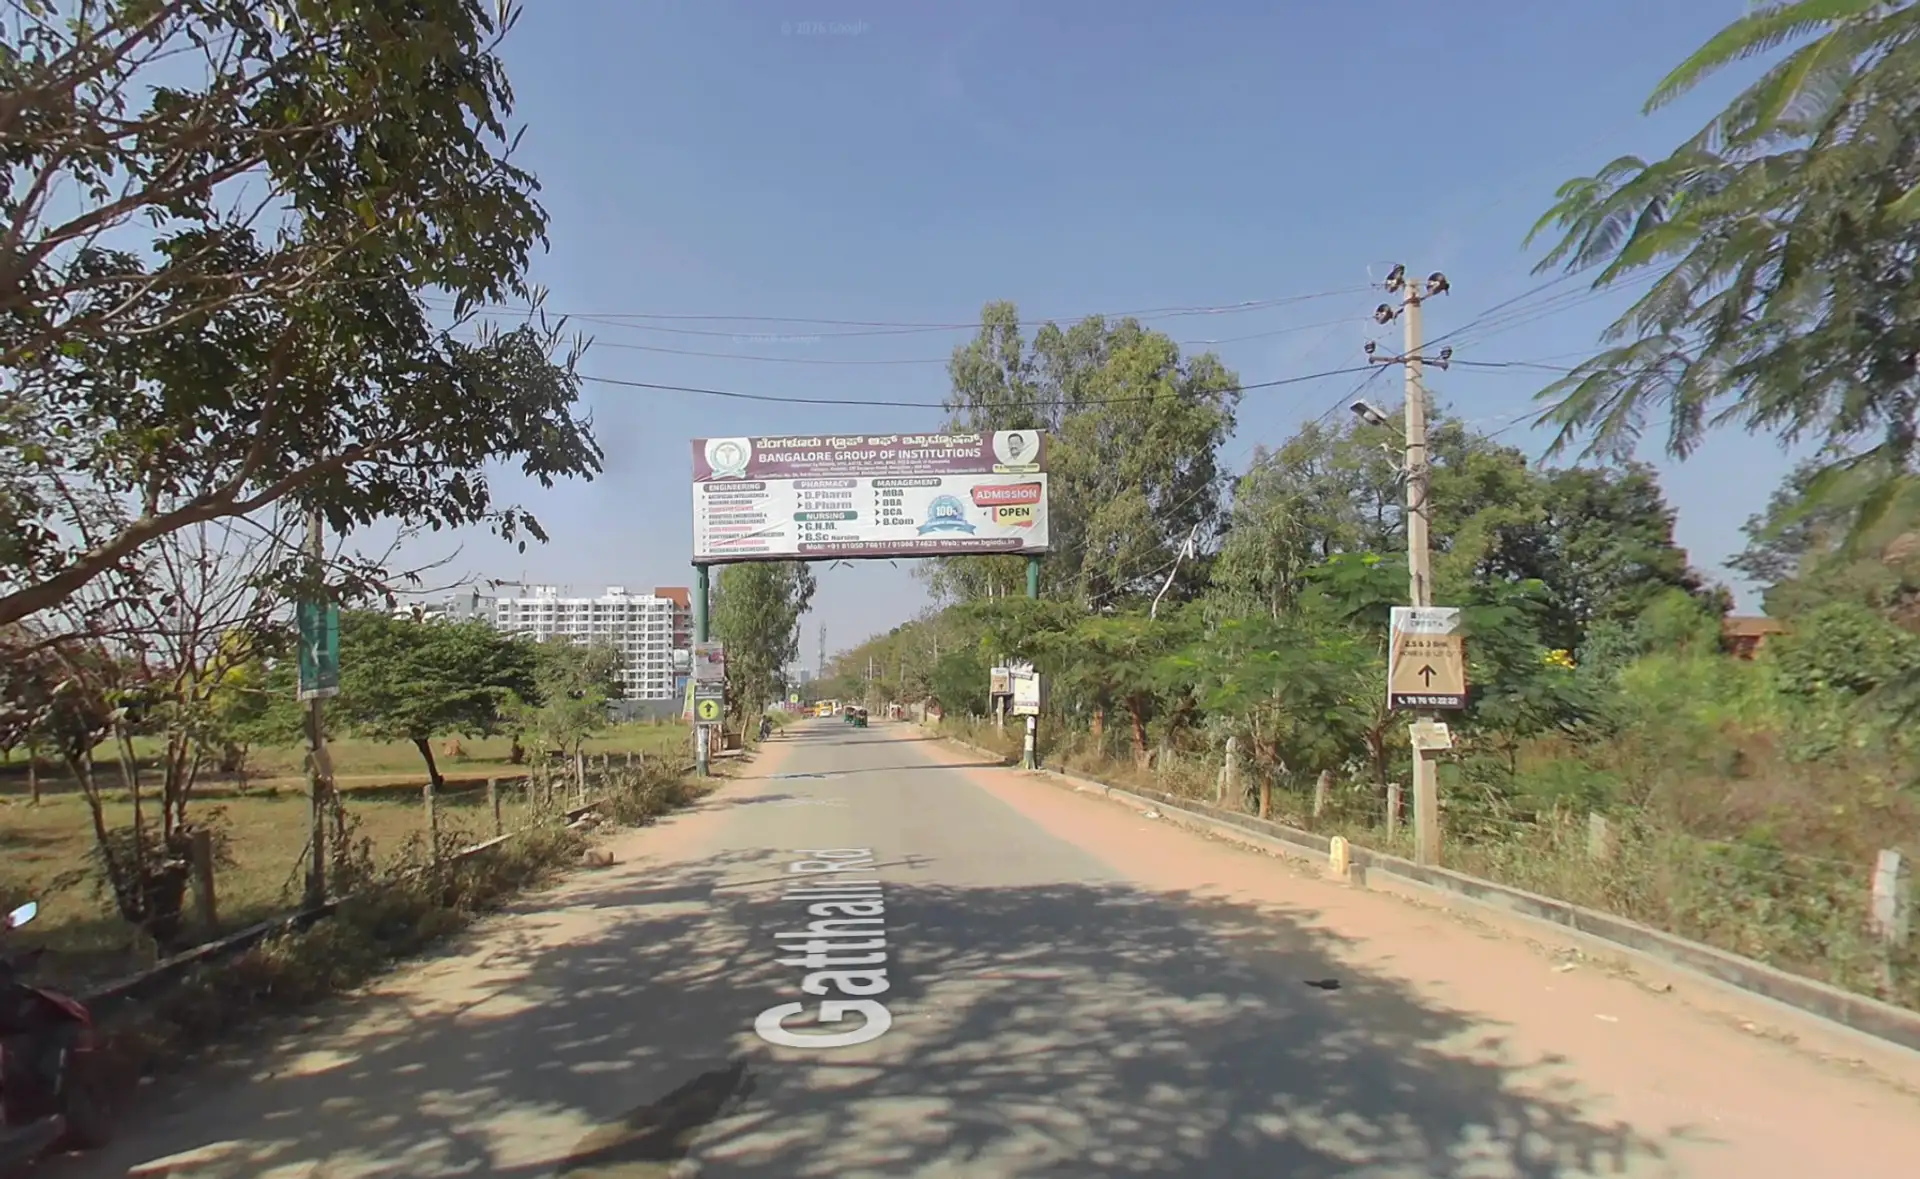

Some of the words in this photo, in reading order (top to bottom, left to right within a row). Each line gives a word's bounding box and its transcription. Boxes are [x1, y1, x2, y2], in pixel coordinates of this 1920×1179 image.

[759, 451, 832, 463] BANGALORE
[835, 451, 877, 461] GROUP
[880, 450, 895, 460] OF
[898, 448, 981, 459] INSTITUTIONS
[801, 480, 849, 488] PHARMACY
[877, 478, 940, 487] MANAGEMENT
[708, 483, 761, 492] ENGINEERING
[882, 489, 904, 497] MBA
[976, 489, 1038, 500] ADMISSION
[806, 512, 845, 520] NURSING
[999, 507, 1031, 517] OPEN
[883, 517, 914, 526] B.Com
